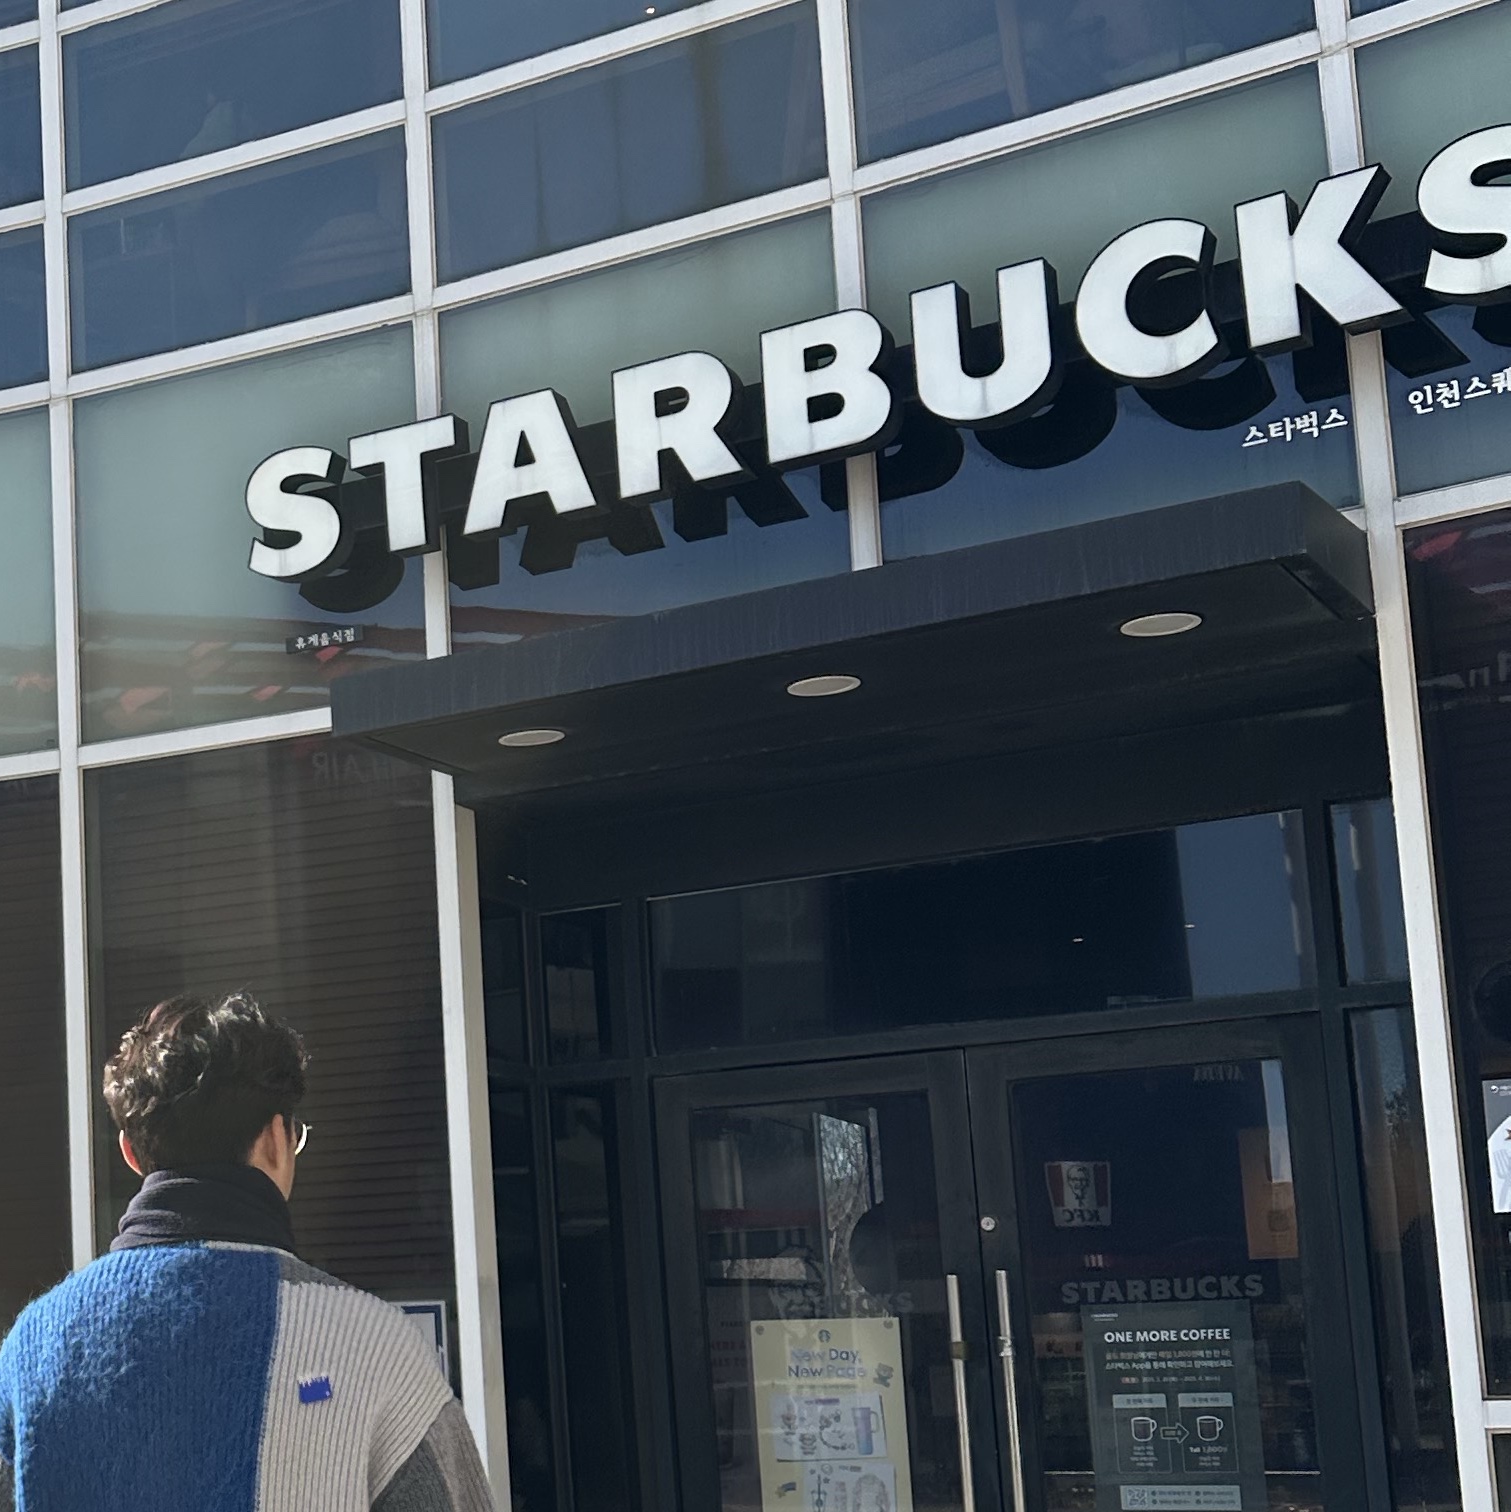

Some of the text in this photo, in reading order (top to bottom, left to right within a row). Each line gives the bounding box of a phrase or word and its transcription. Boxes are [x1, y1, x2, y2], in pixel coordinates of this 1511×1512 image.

[245, 123, 1511, 581] STARBUCKS
[1242, 408, 1349, 448] 스타벅스
[1062, 1275, 1263, 1304] STARBUCKS
[1104, 1328, 1231, 1343] ONE MORE COFFEE
[788, 1365, 824, 1378] New
